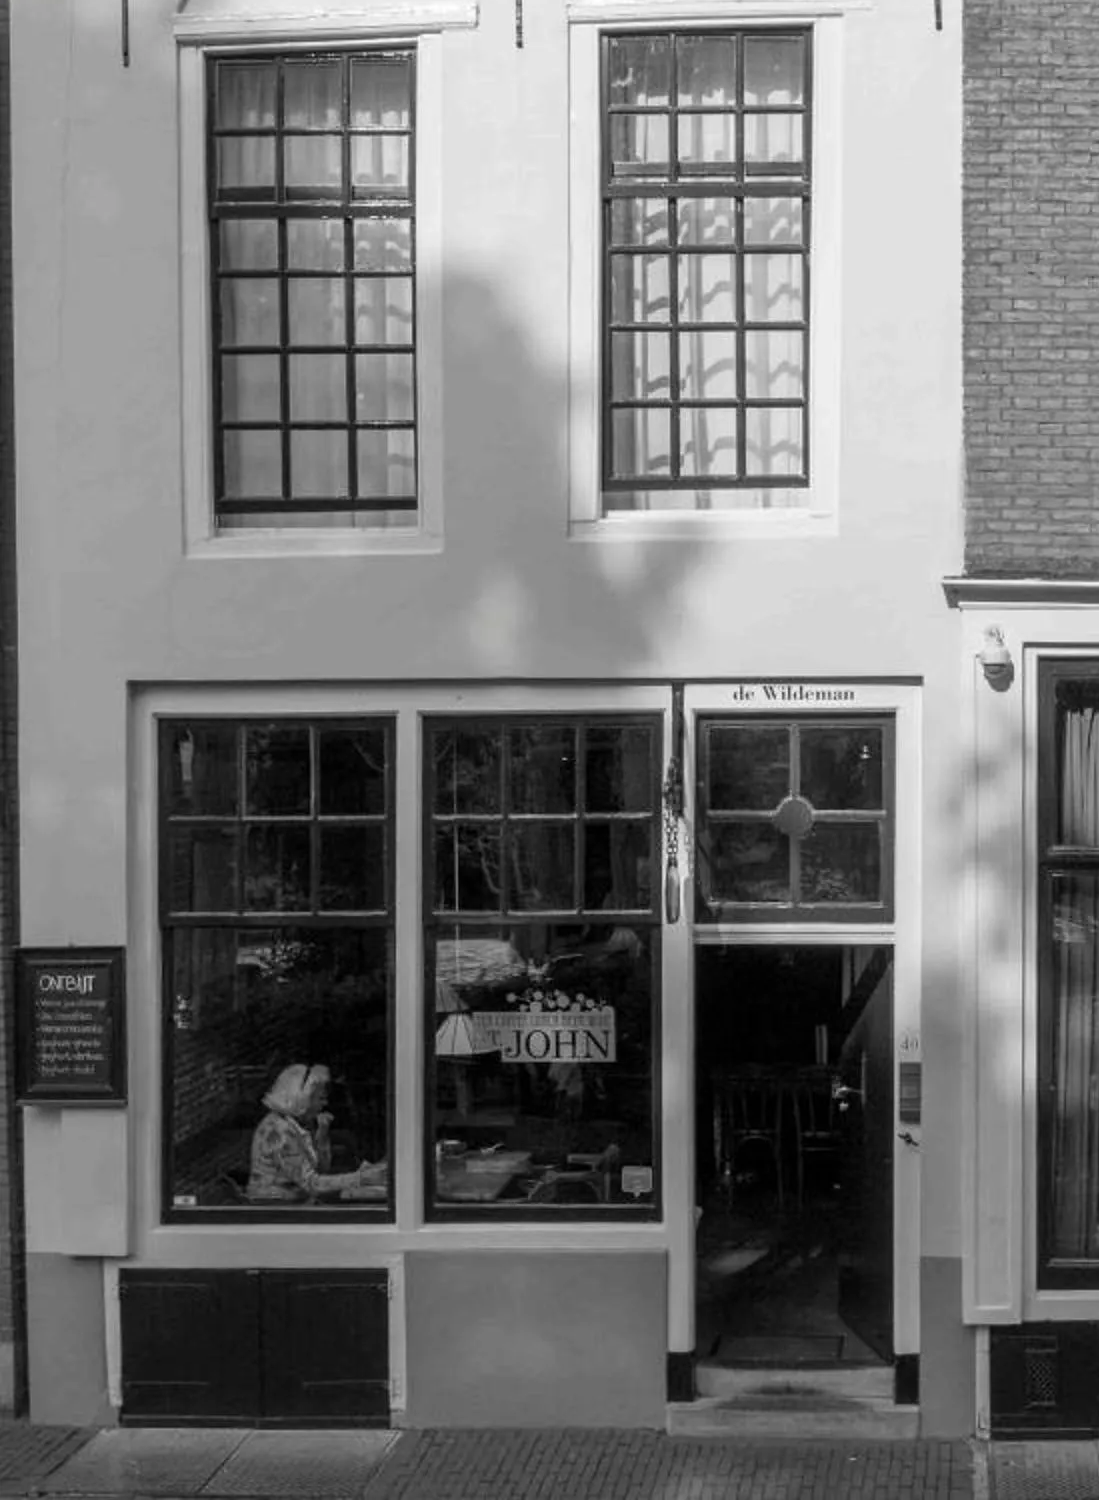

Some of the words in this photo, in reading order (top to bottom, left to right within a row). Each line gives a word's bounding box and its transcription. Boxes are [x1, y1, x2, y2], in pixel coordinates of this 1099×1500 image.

[732, 684, 756, 702] de
[762, 684, 855, 702] Wildeman
[504, 1028, 612, 1059] JOHN
